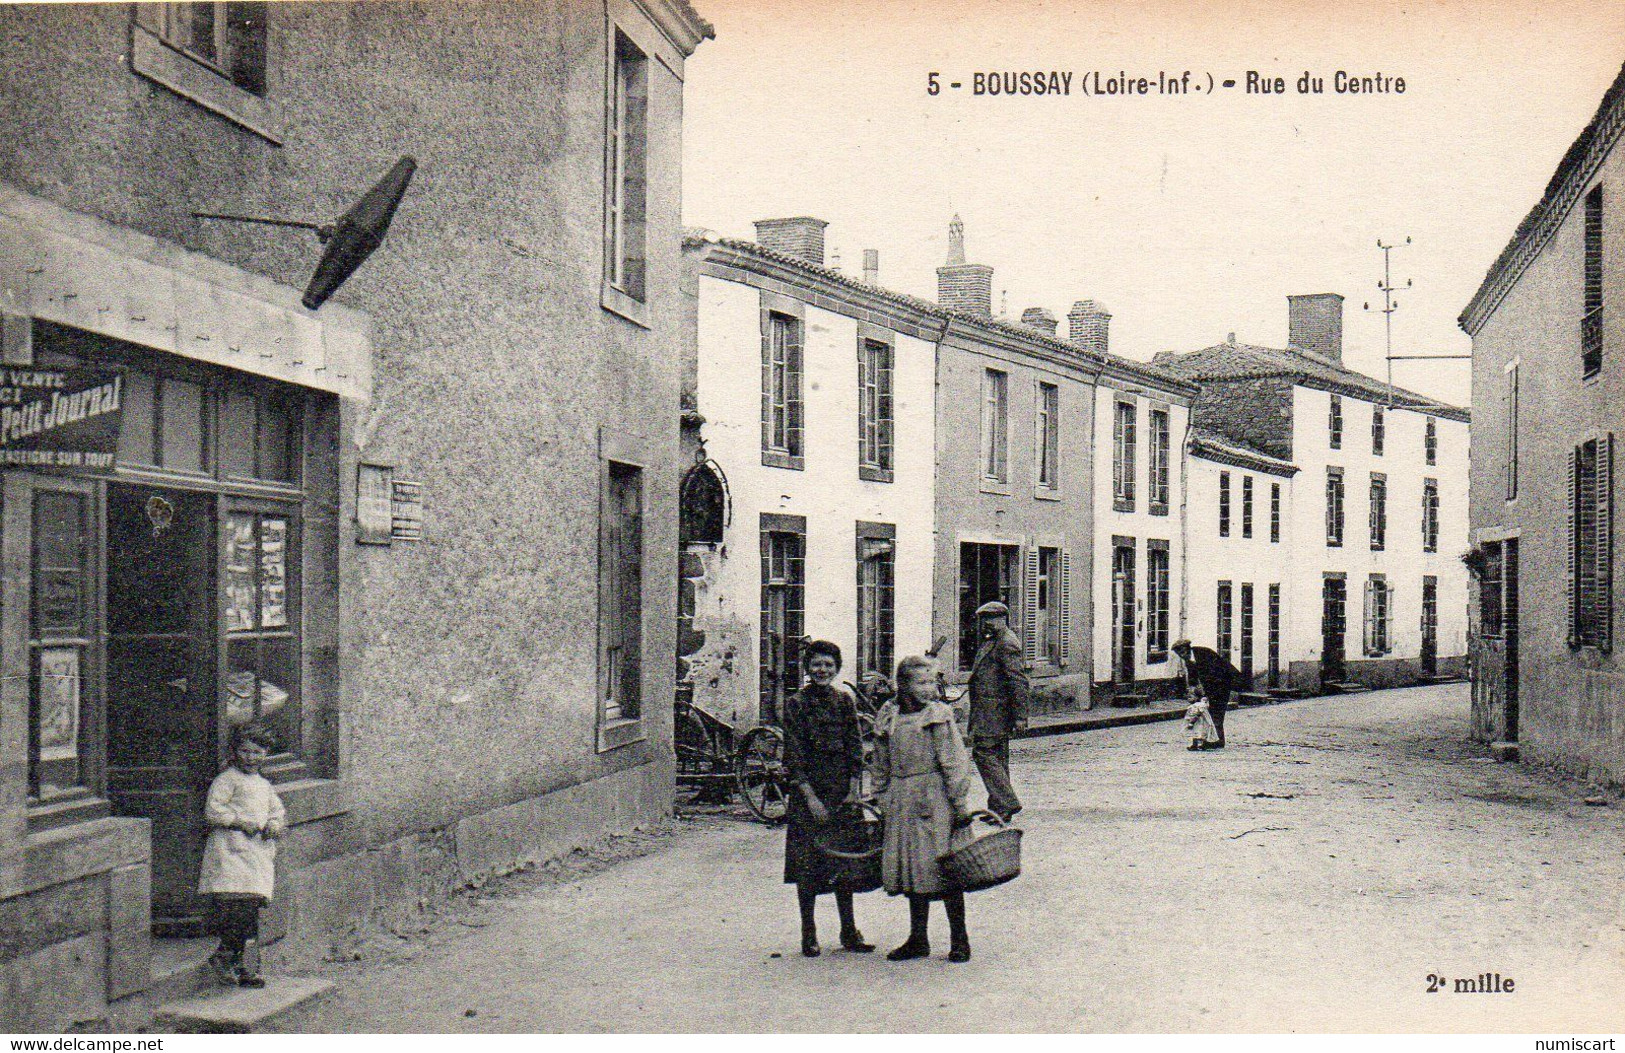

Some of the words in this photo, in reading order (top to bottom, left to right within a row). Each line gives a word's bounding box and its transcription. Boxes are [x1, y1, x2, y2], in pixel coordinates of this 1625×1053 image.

[10, 371, 64, 389] VENTE
[1, 400, 42, 443] Petit
[43, 376, 121, 430] Journal
[57, 450, 81, 466] SUR
[84, 451, 114, 469] TOUT
